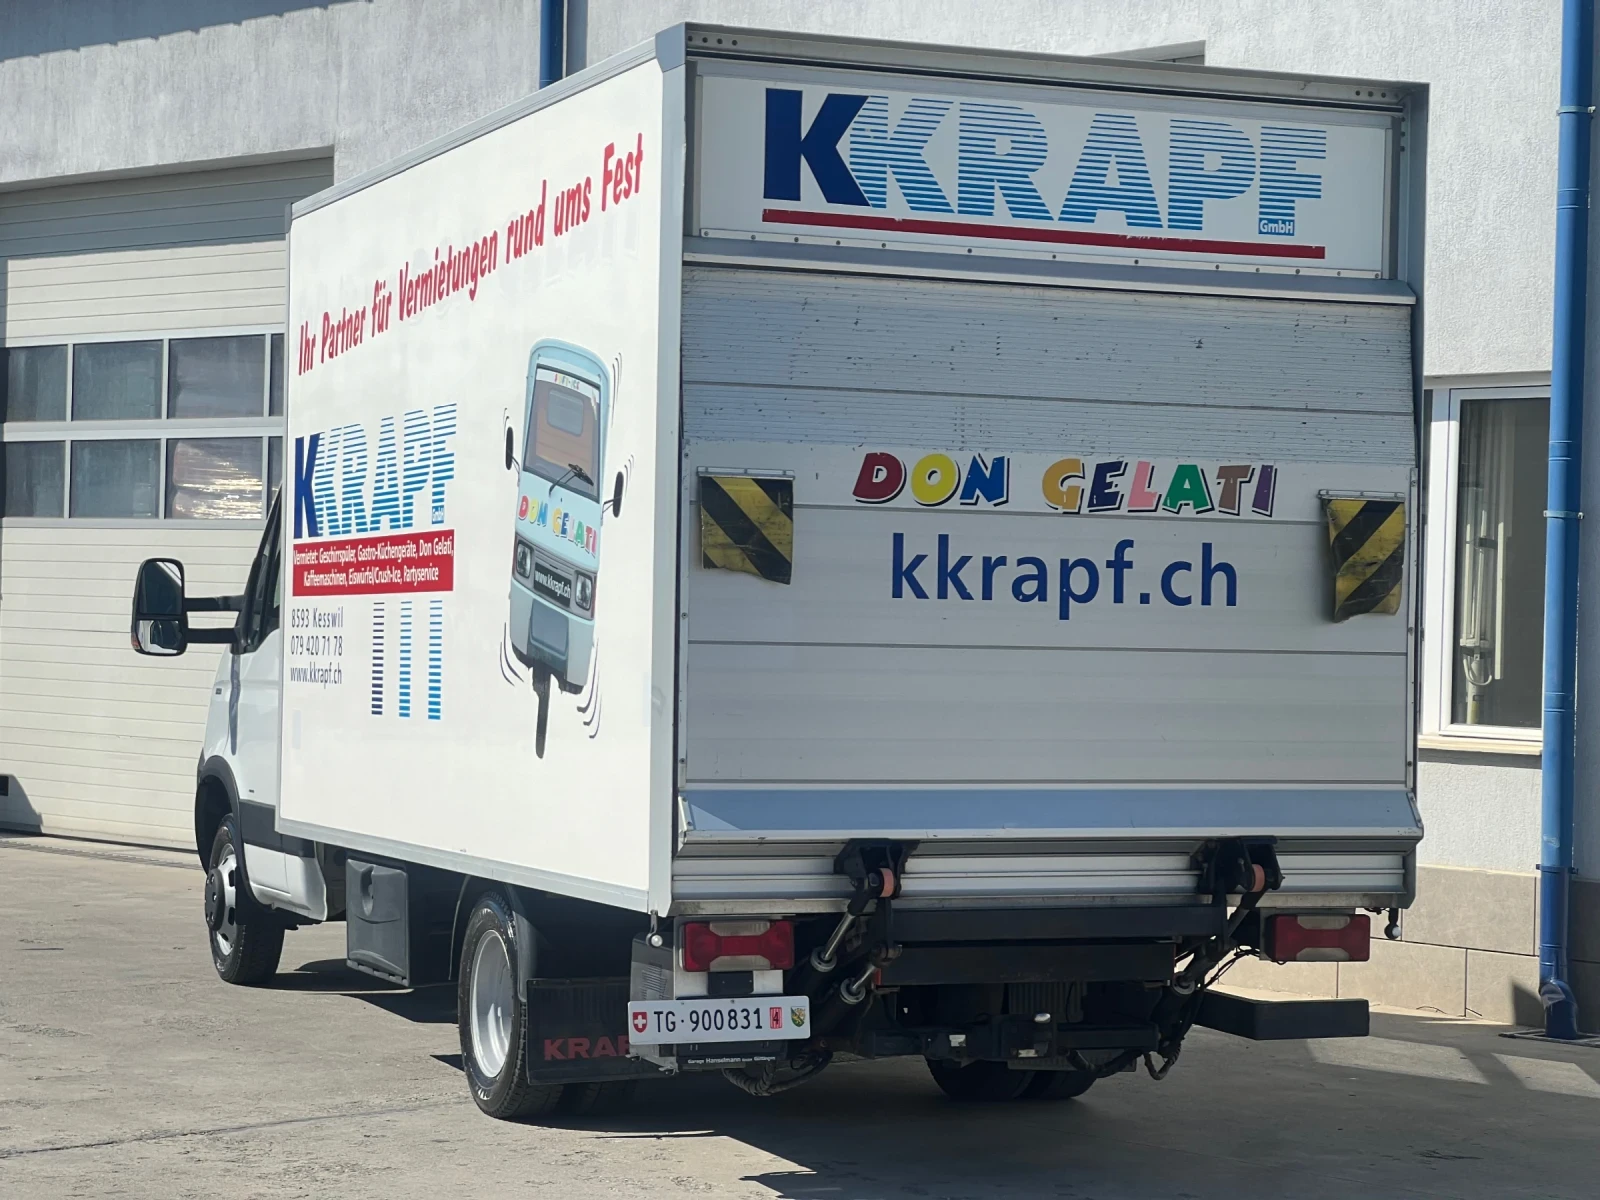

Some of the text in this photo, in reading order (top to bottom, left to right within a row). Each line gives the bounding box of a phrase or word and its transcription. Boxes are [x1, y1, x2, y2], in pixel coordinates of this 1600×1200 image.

[1260, 219, 1294, 234] GmbH
[298, 132, 643, 376] Ihr Partner für Vermietungen rund ums Fest
[851, 452, 1278, 517] DON GELATI
[518, 495, 598, 559] DON GELATI
[294, 535, 454, 567] Vermietet: Geschirrspüler, Gastro-Küchengeräte, Don Gelati,
[303, 568, 348, 588] Kaffeemaschinen,
[403, 562, 439, 587] Partyservice
[534, 570, 571, 598] www.kkrapf.ch
[891, 532, 1238, 620] kkrapf.ch
[291, 605, 344, 628] 8593 Kesswil
[290, 635, 343, 656] 079 420 71 78
[290, 661, 343, 689] www.kkrapf.ch
